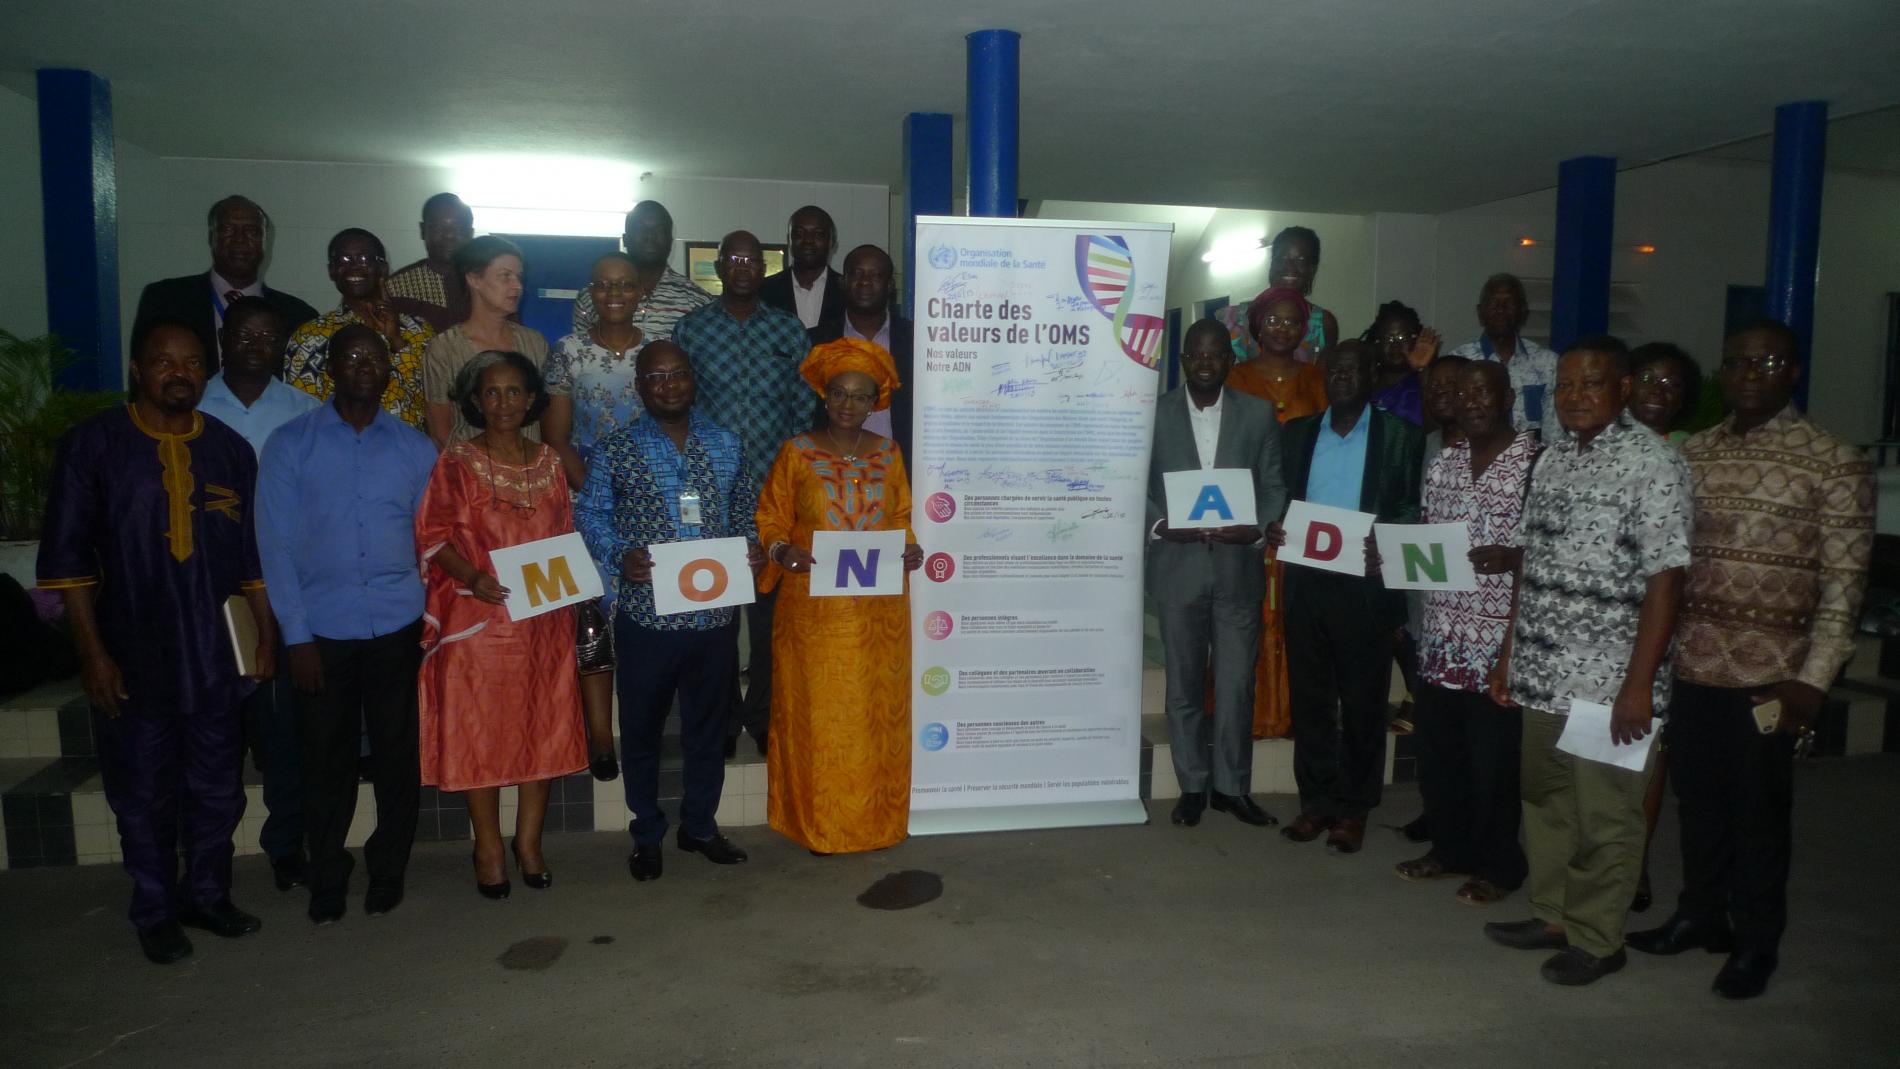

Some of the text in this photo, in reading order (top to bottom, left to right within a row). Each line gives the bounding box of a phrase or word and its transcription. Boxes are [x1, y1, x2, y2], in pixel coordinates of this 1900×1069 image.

[960, 247, 1012, 260] Organisation
[960, 258, 1047, 269] mondiale de la Santé
[927, 297, 993, 320] Charte
[998, 299, 1032, 321] des
[927, 322, 1001, 344] valeurs
[1007, 323, 1029, 344] de
[926, 347, 978, 359] Nos valeurs
[926, 361, 971, 372] Notre ADN
[1188, 485, 1233, 520] A
[1303, 520, 1343, 561] D
[835, 549, 880, 588] N
[1401, 543, 1448, 582] N
[521, 556, 579, 608] M
[678, 558, 728, 602] O
